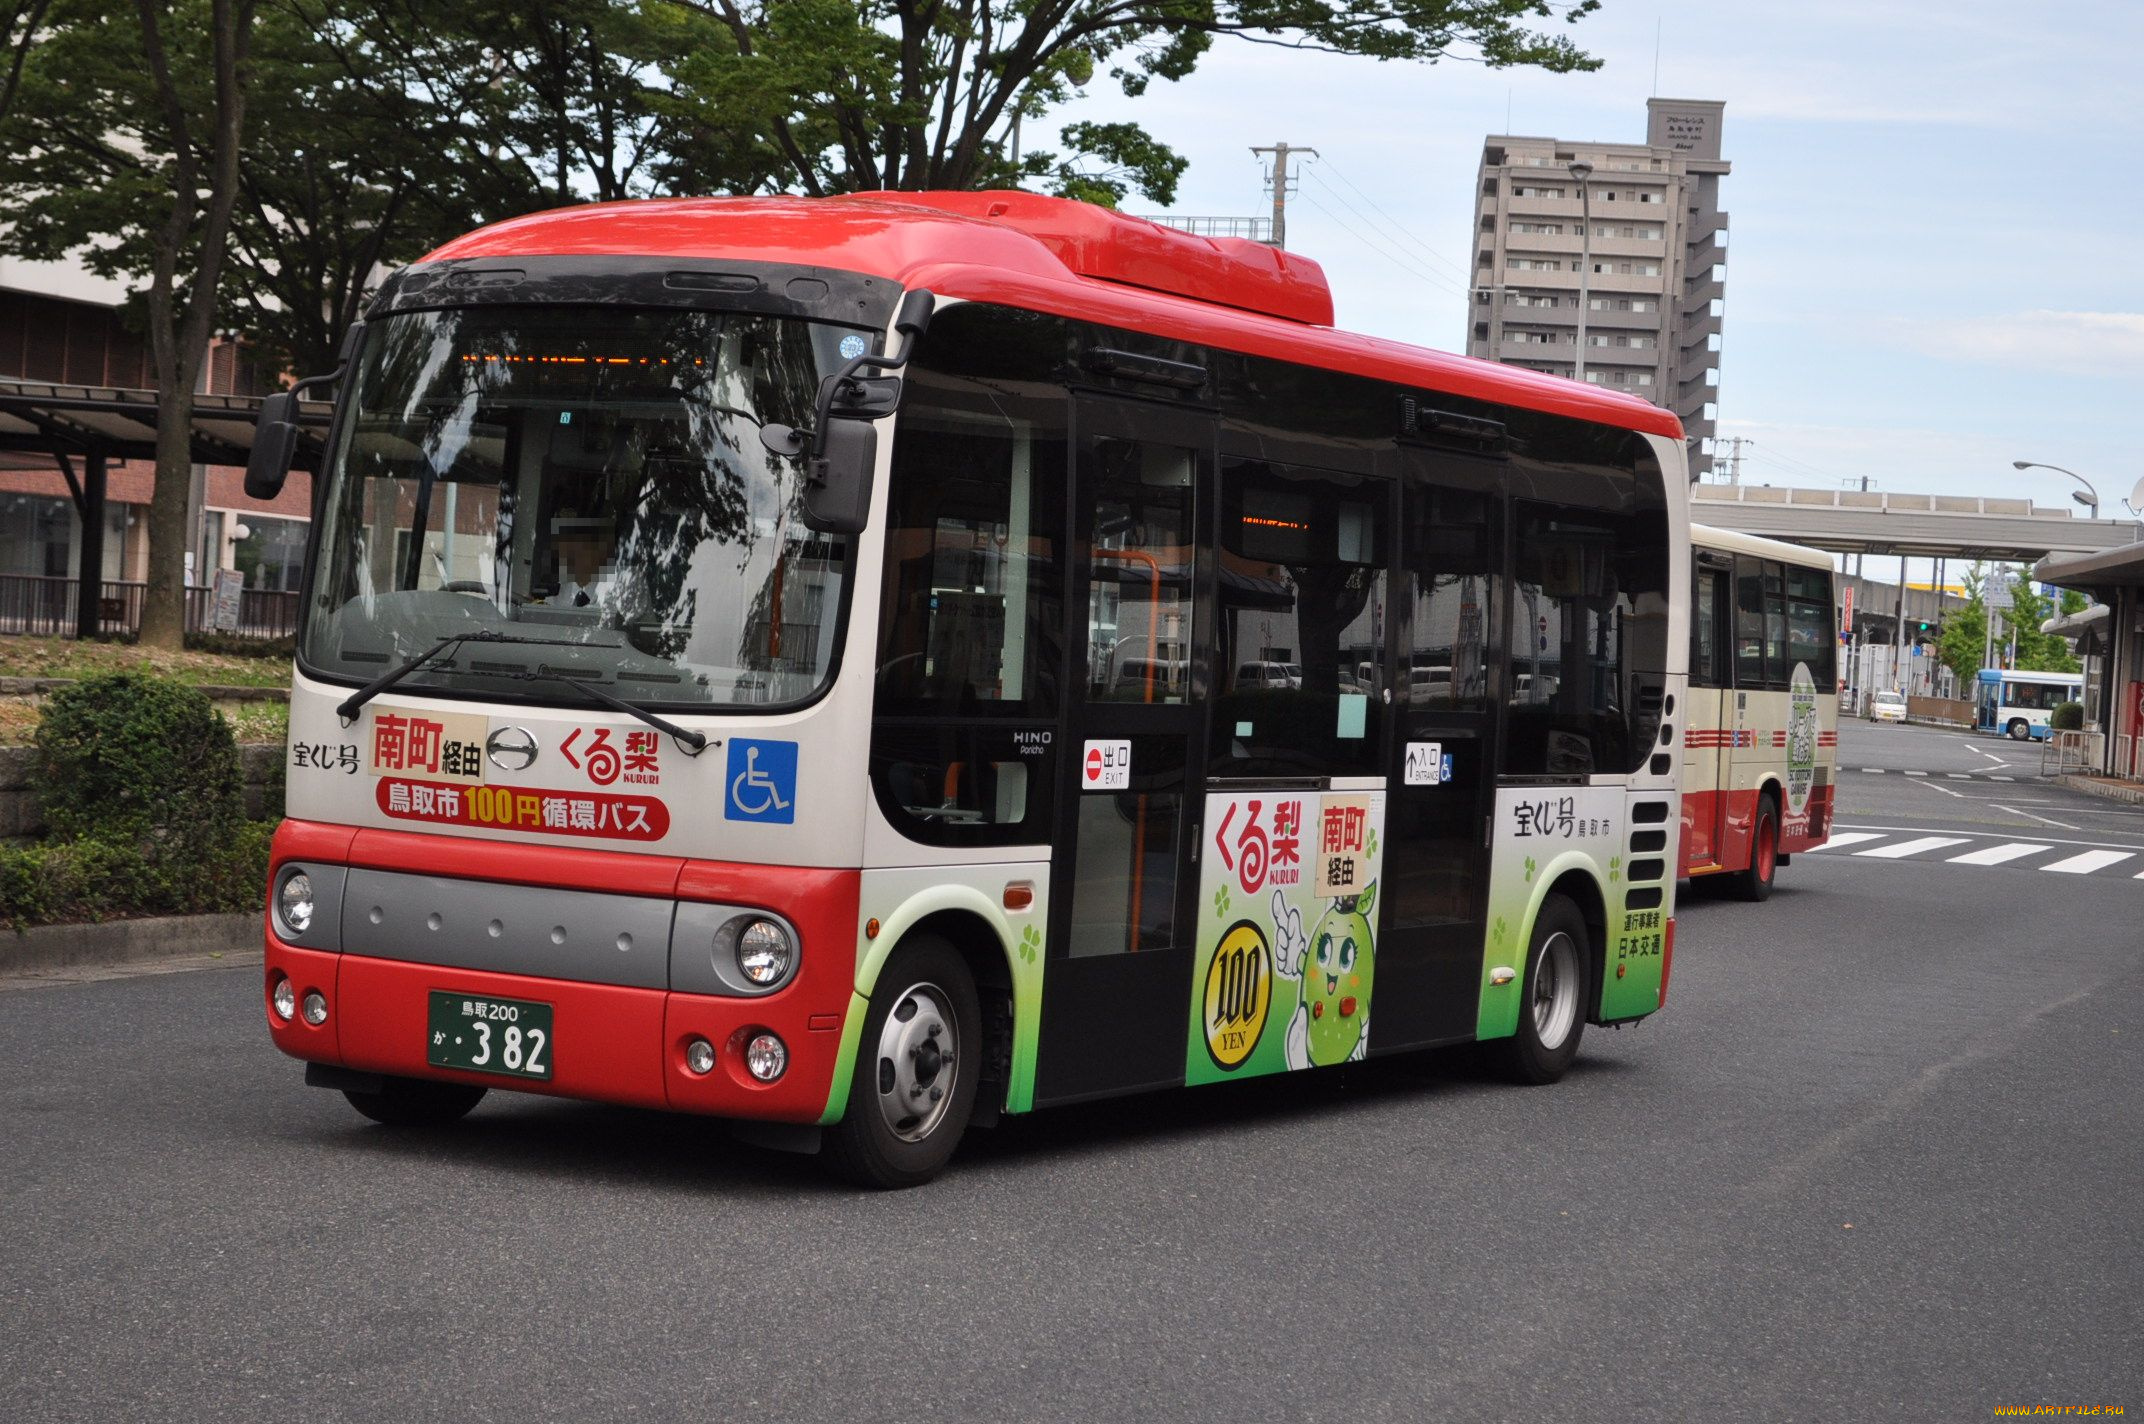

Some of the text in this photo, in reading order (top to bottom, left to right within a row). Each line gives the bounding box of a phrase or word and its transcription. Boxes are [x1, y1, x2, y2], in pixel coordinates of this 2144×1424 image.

[1013, 732, 1052, 744] HINO
[293, 741, 361, 775] 宝くじ号
[559, 727, 660, 786] くる梨
[1103, 745, 1128, 768] 出口
[1419, 747, 1438, 767] 入口
[623, 773, 660, 785] KURURI
[1105, 772, 1124, 785] EXIT
[1415, 770, 1439, 781] ENTRANCE
[1322, 805, 1365, 854] 南町
[1513, 796, 1576, 839] 宝くじ号
[1215, 799, 1301, 894] くる梨
[1269, 868, 1299, 886] KURURI
[1327, 856, 1355, 887] 経由
[1618, 933, 1661, 959] 日本交通
[1213, 944, 1261, 1030] 100
[1222, 1030, 1247, 1051] YEN
